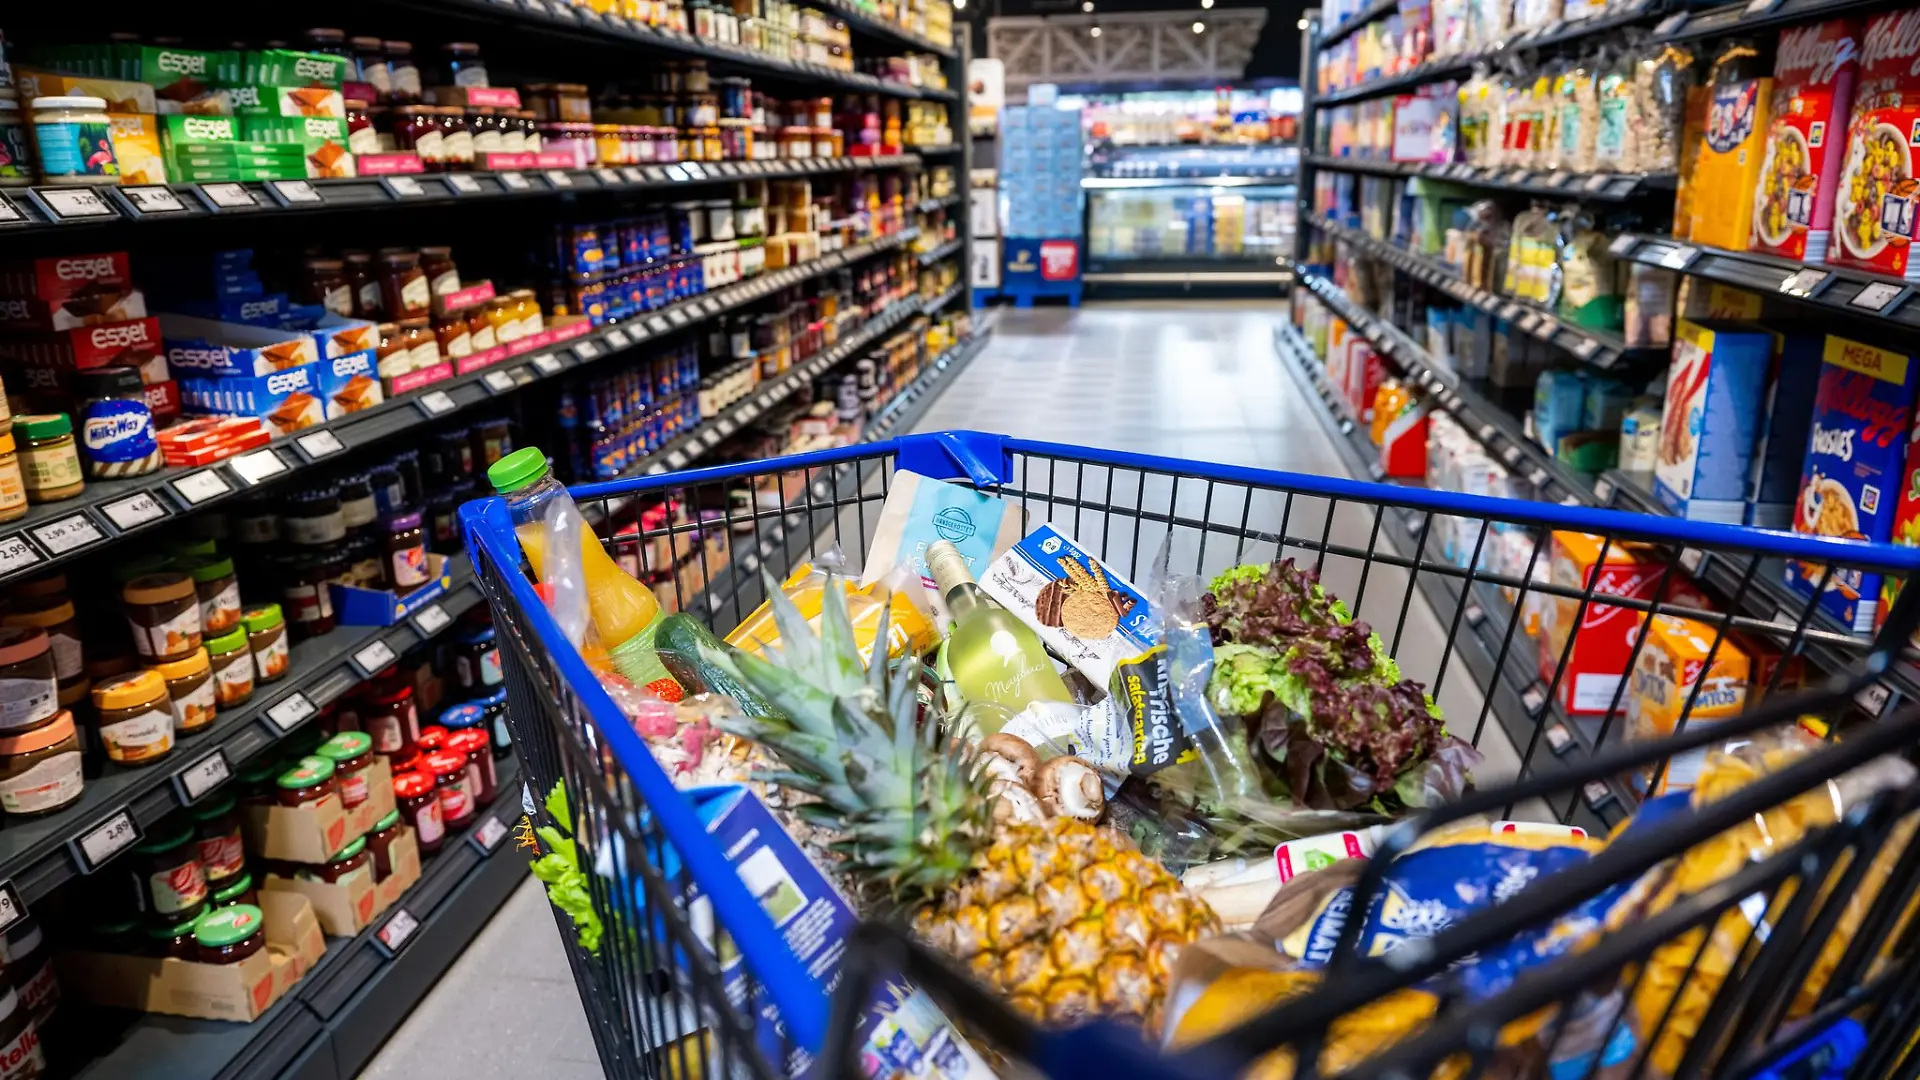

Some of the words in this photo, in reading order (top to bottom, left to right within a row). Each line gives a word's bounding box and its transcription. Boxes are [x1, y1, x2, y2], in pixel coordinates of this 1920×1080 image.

[1840, 343, 1882, 373] MEGA
[1, 541, 28, 561] 2,99
[106, 820, 129, 840] 2,89
